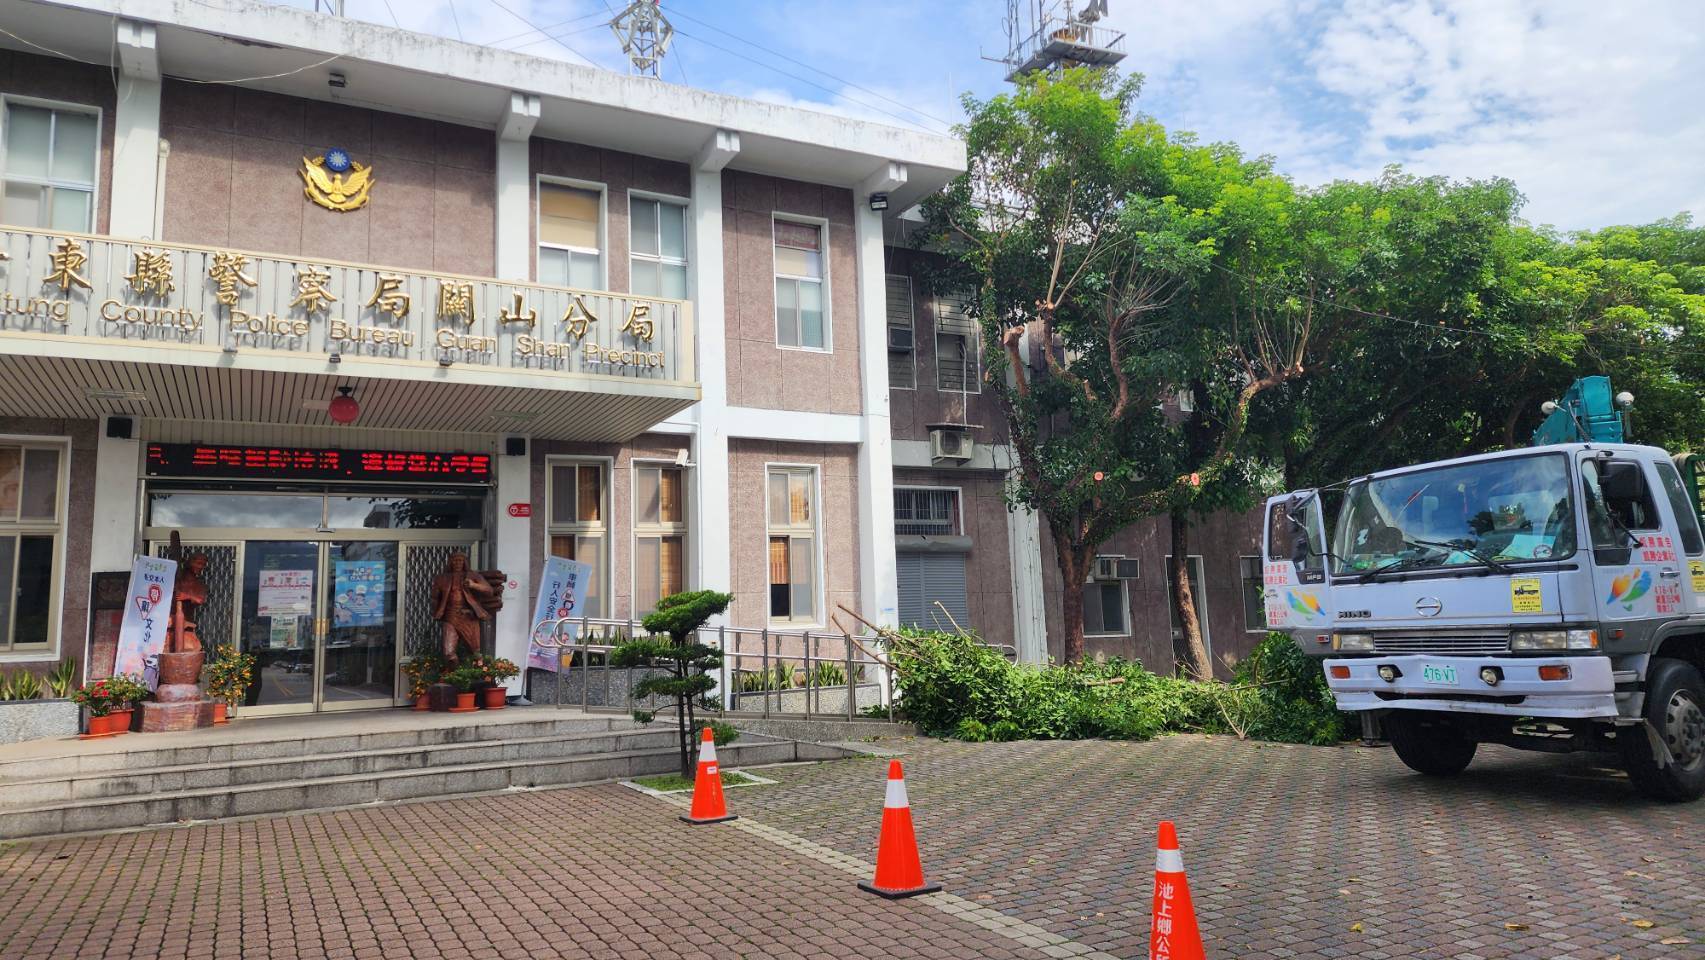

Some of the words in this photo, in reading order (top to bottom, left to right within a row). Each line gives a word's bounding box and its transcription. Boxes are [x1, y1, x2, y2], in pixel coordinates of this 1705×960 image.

[0, 237, 655, 343] 東縣警察局關山分局
[100, 299, 203, 332] County
[229, 308, 309, 336] Police
[329, 318, 415, 347] Bureau
[436, 328, 497, 354] Guan
[516, 334, 571, 360] Shan
[582, 341, 666, 369] Precinct
